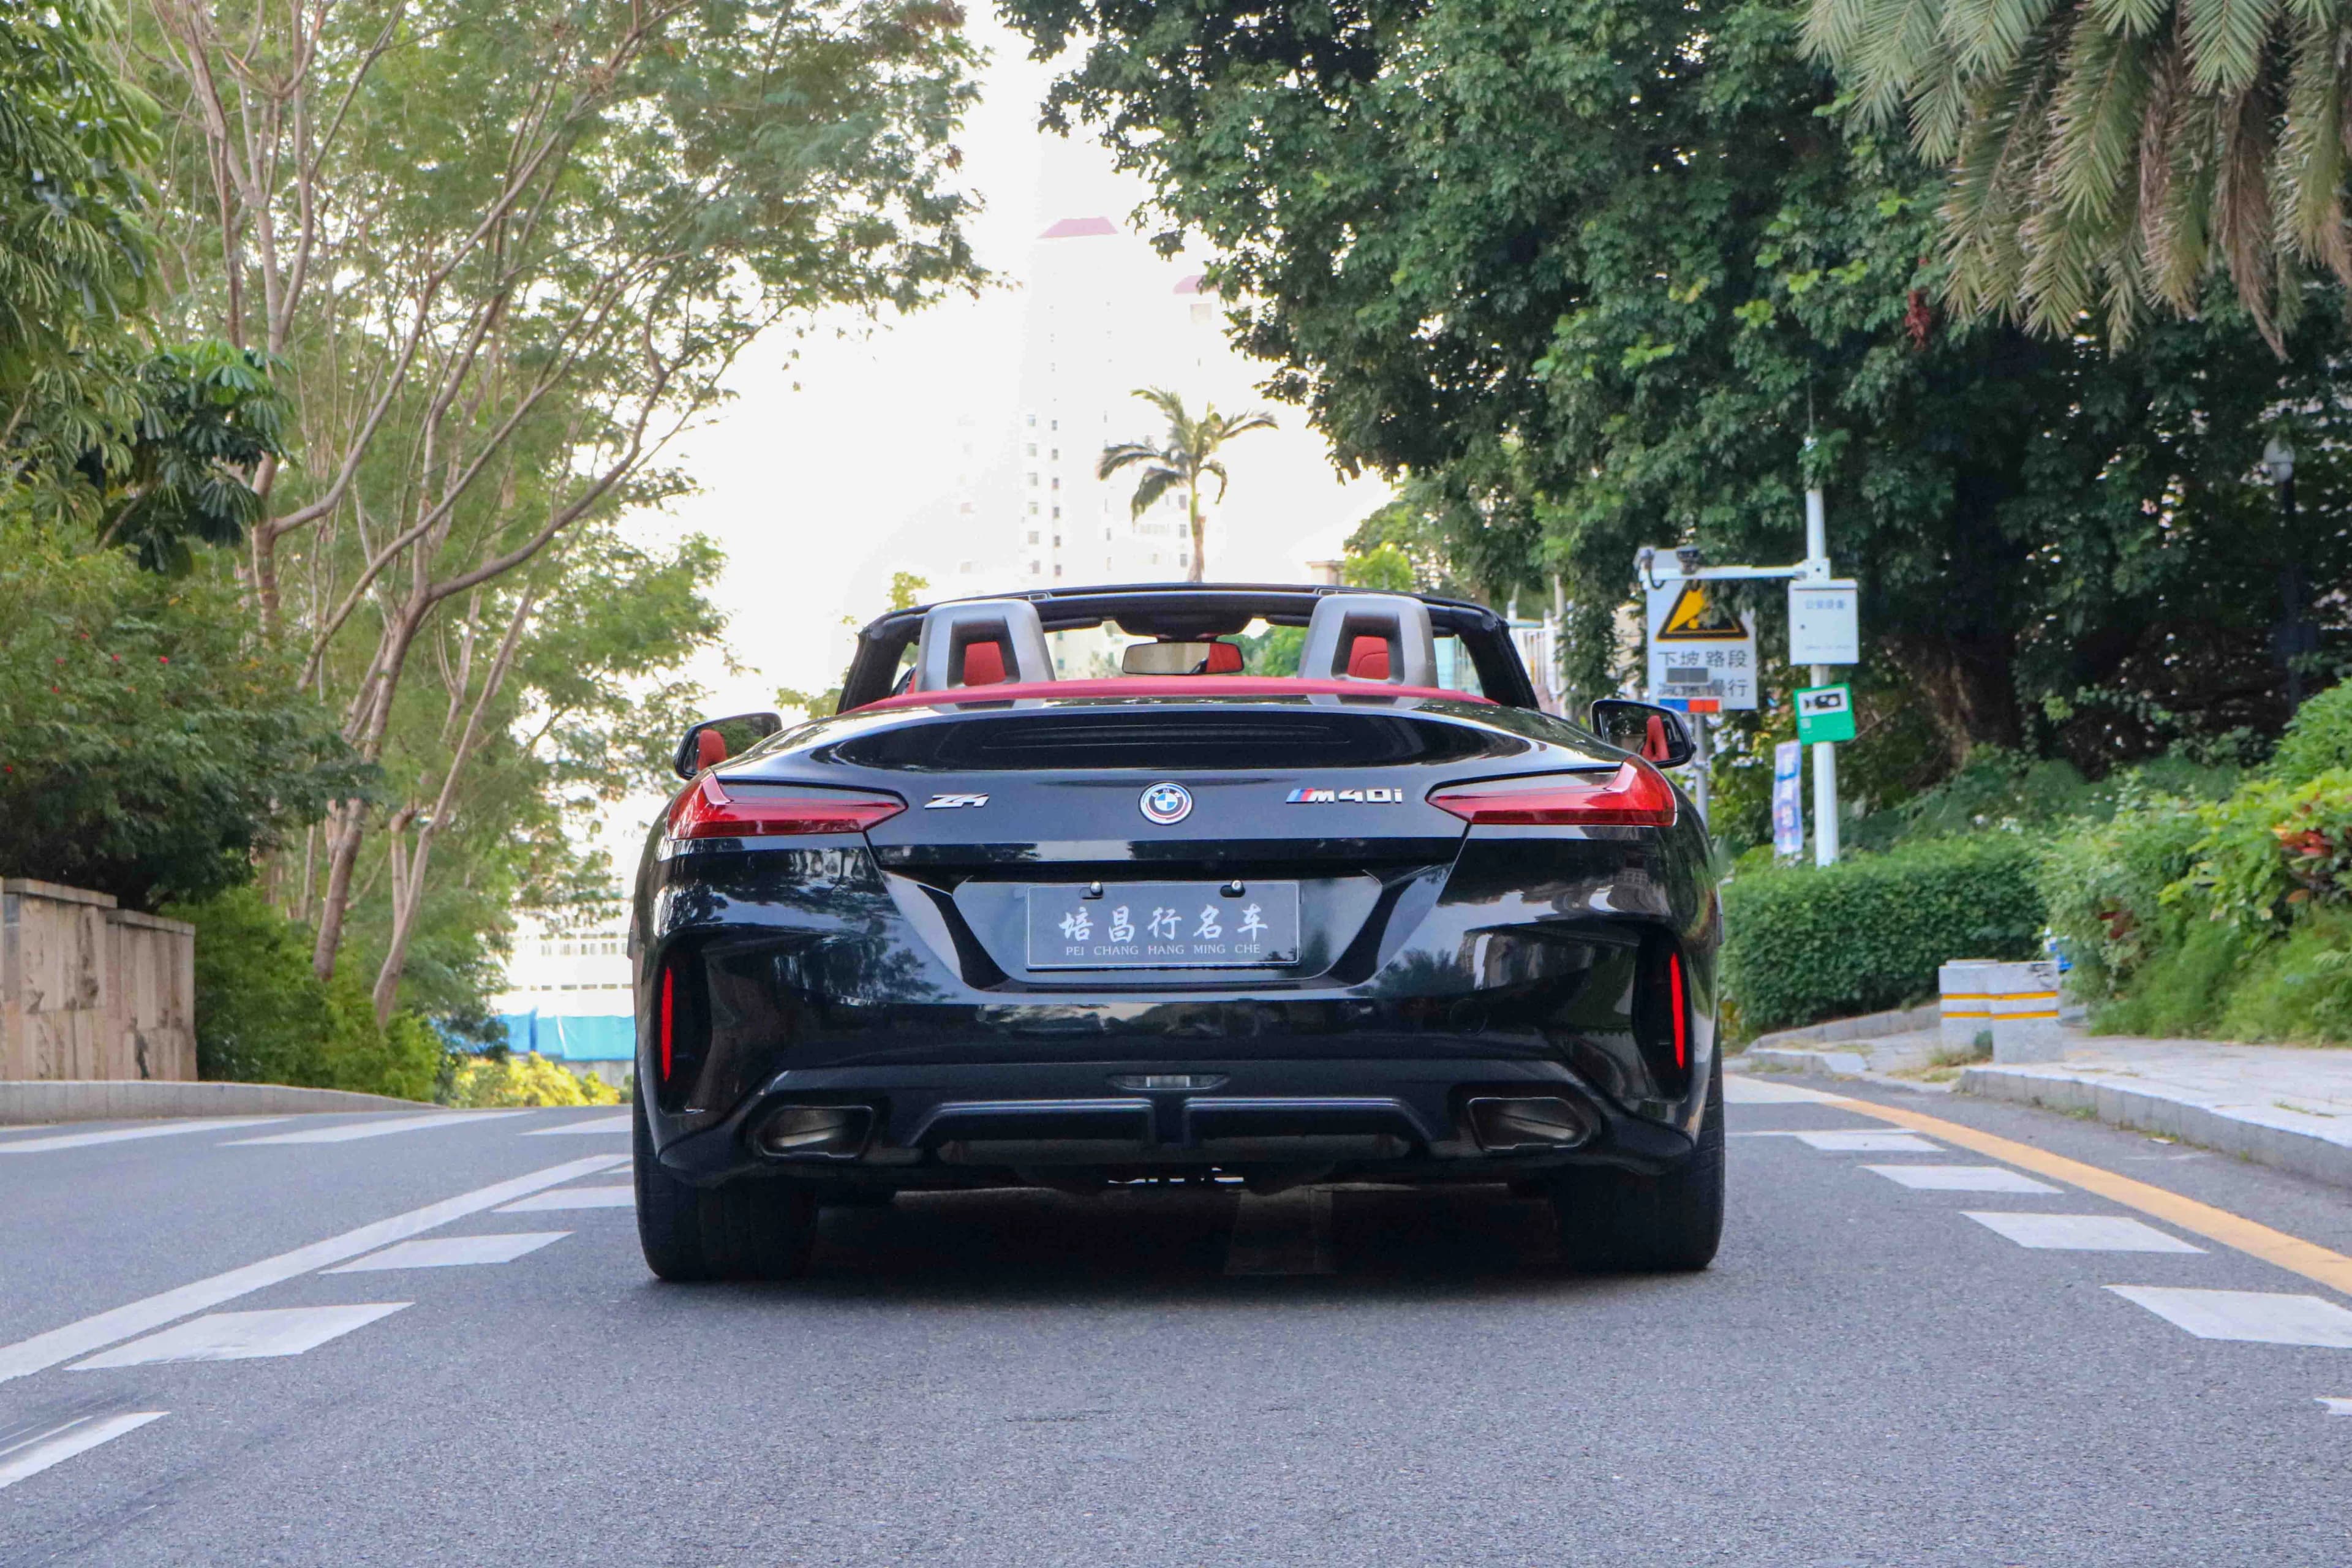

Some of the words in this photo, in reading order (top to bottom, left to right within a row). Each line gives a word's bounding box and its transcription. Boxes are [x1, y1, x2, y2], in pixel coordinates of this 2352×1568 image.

[1657, 649, 1748, 668] 下坡路段
[924, 793, 990, 809] Z4
[1286, 789, 1402, 804] M40i
[1058, 903, 1268, 943] 培昌行名车
[1066, 946, 1085, 956] PEI
[1094, 944, 1139, 956] CHANG
[1148, 944, 1185, 955] HANG
[1193, 944, 1226, 954] MING
[1234, 943, 1261, 954] CHE
